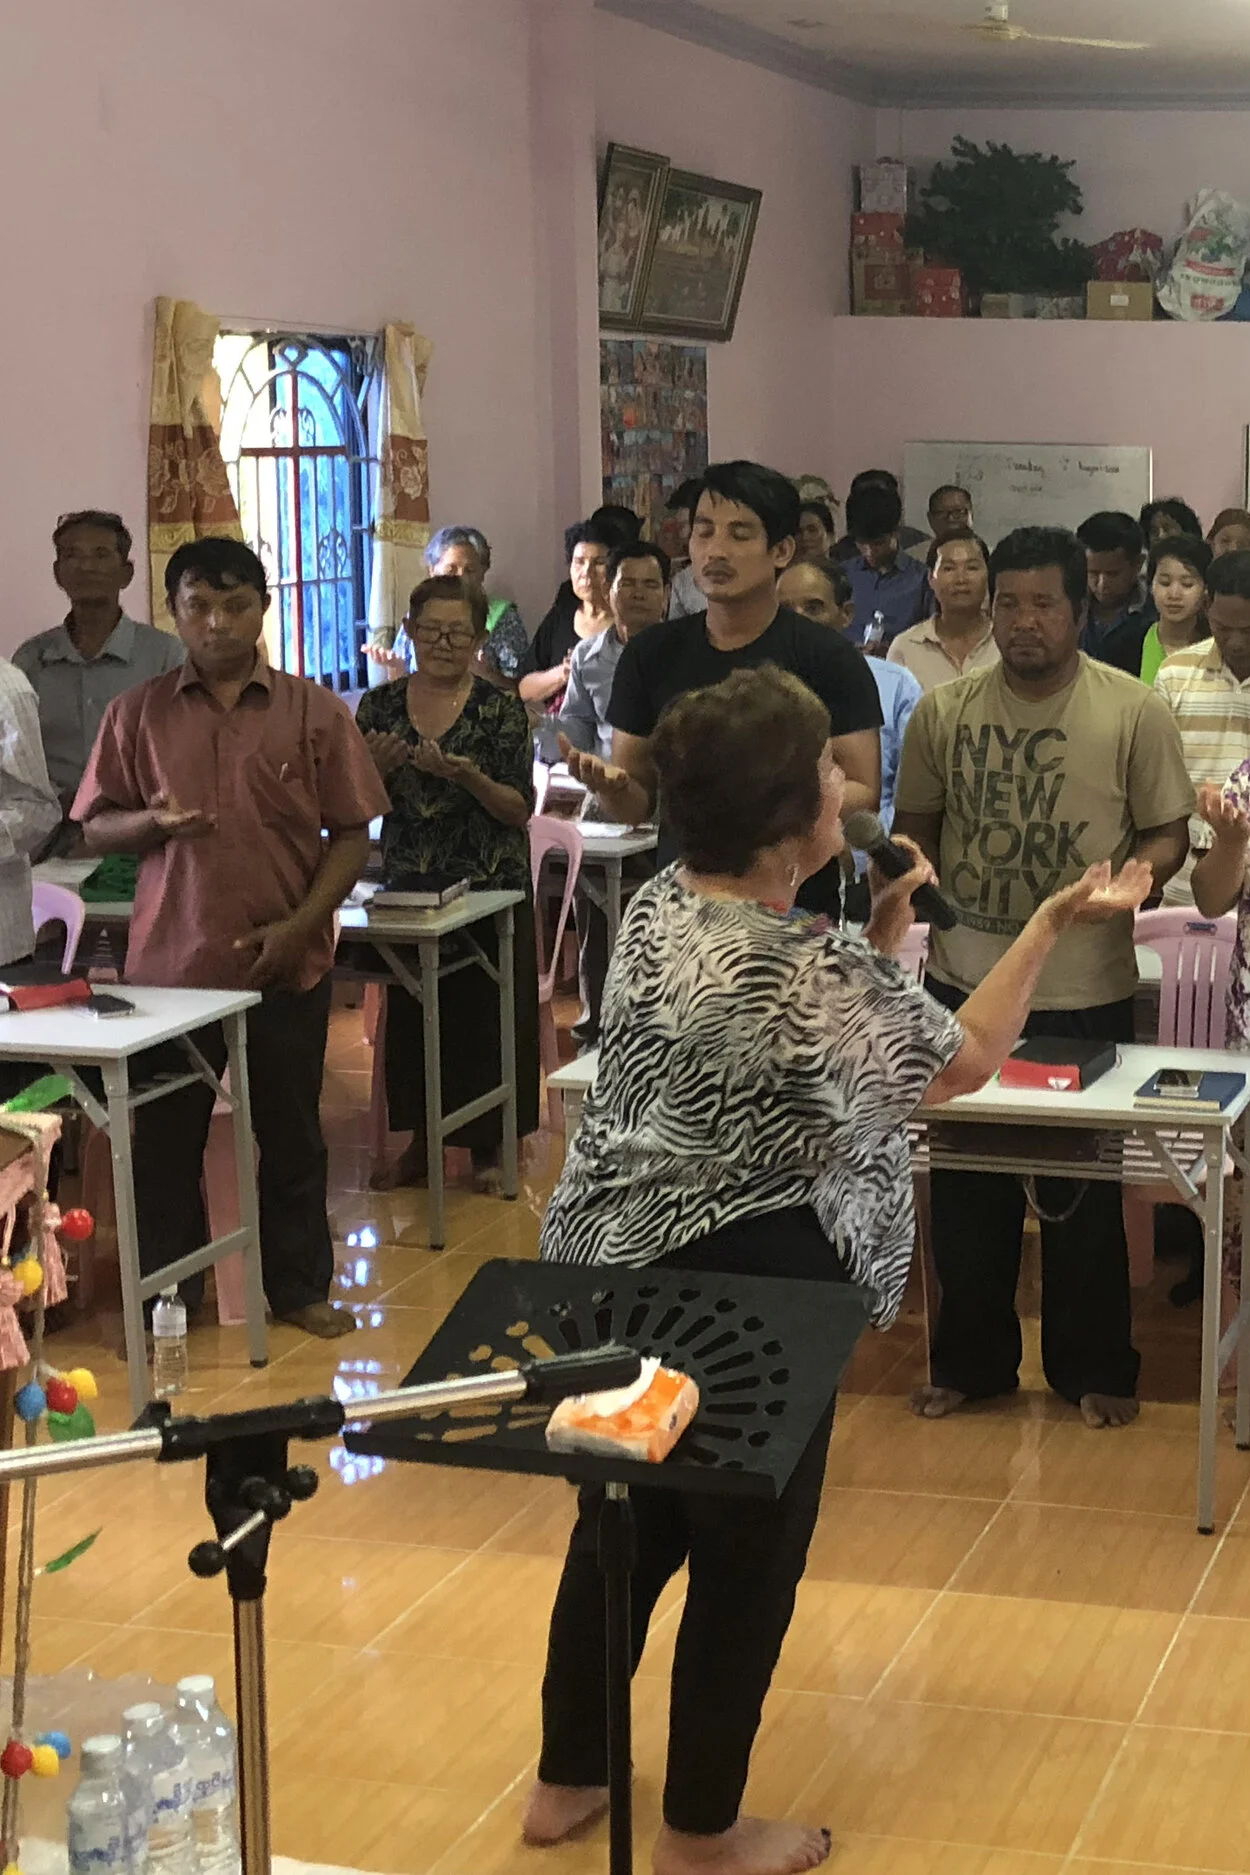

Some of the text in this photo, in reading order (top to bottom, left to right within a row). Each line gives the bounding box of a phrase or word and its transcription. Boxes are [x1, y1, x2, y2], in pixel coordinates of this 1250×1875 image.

[952, 723, 1067, 773] NYC
[952, 770, 1066, 821] NEW
[961, 818, 1090, 869] YORK
[951, 860, 1061, 915] CITY
